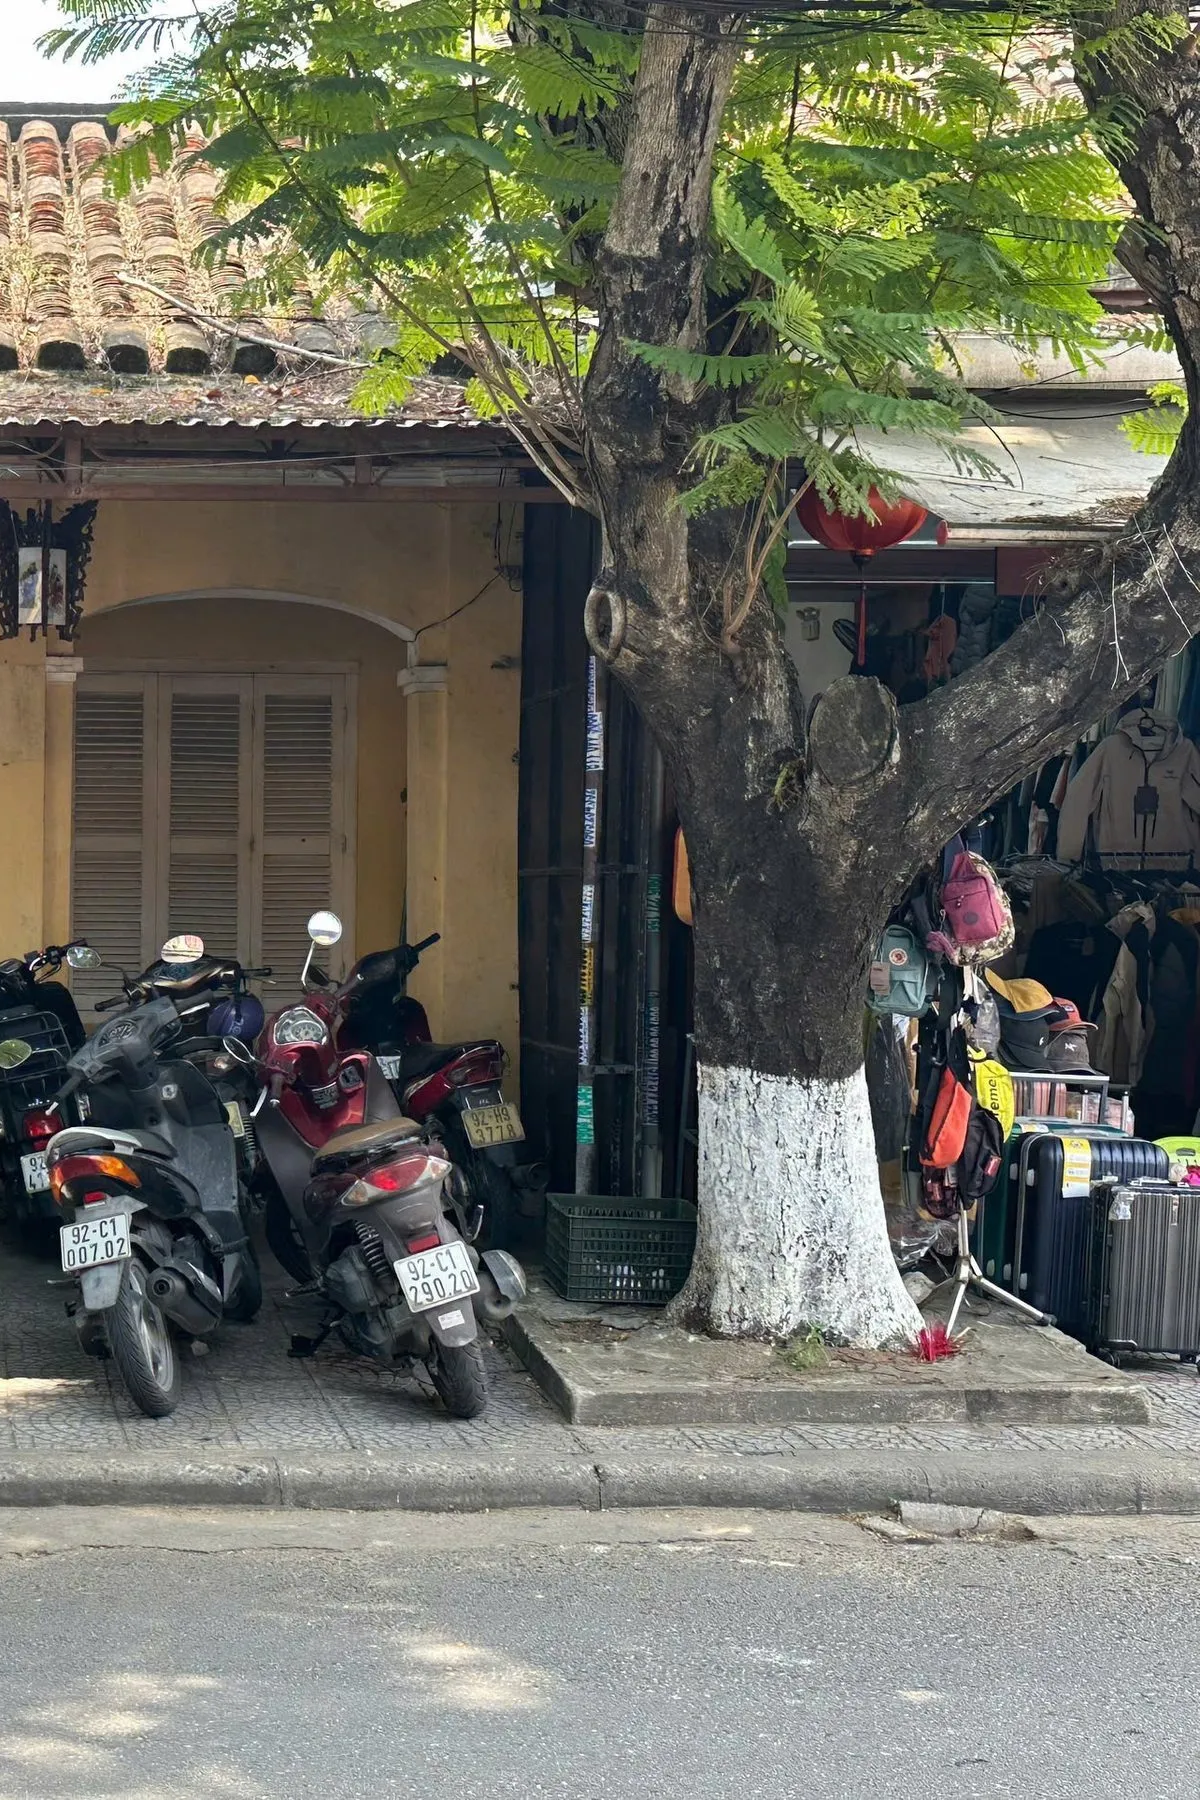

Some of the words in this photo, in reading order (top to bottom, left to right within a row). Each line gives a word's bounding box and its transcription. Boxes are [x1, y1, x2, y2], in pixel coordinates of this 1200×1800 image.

[471, 1106, 510, 1127] 92-H9
[475, 1123, 516, 1144] 3778
[72, 1218, 116, 1244] 92-C1
[67, 1237, 127, 1267] 007.02
[407, 1249, 457, 1281] 92-C1
[409, 1269, 473, 1306] 290.20
